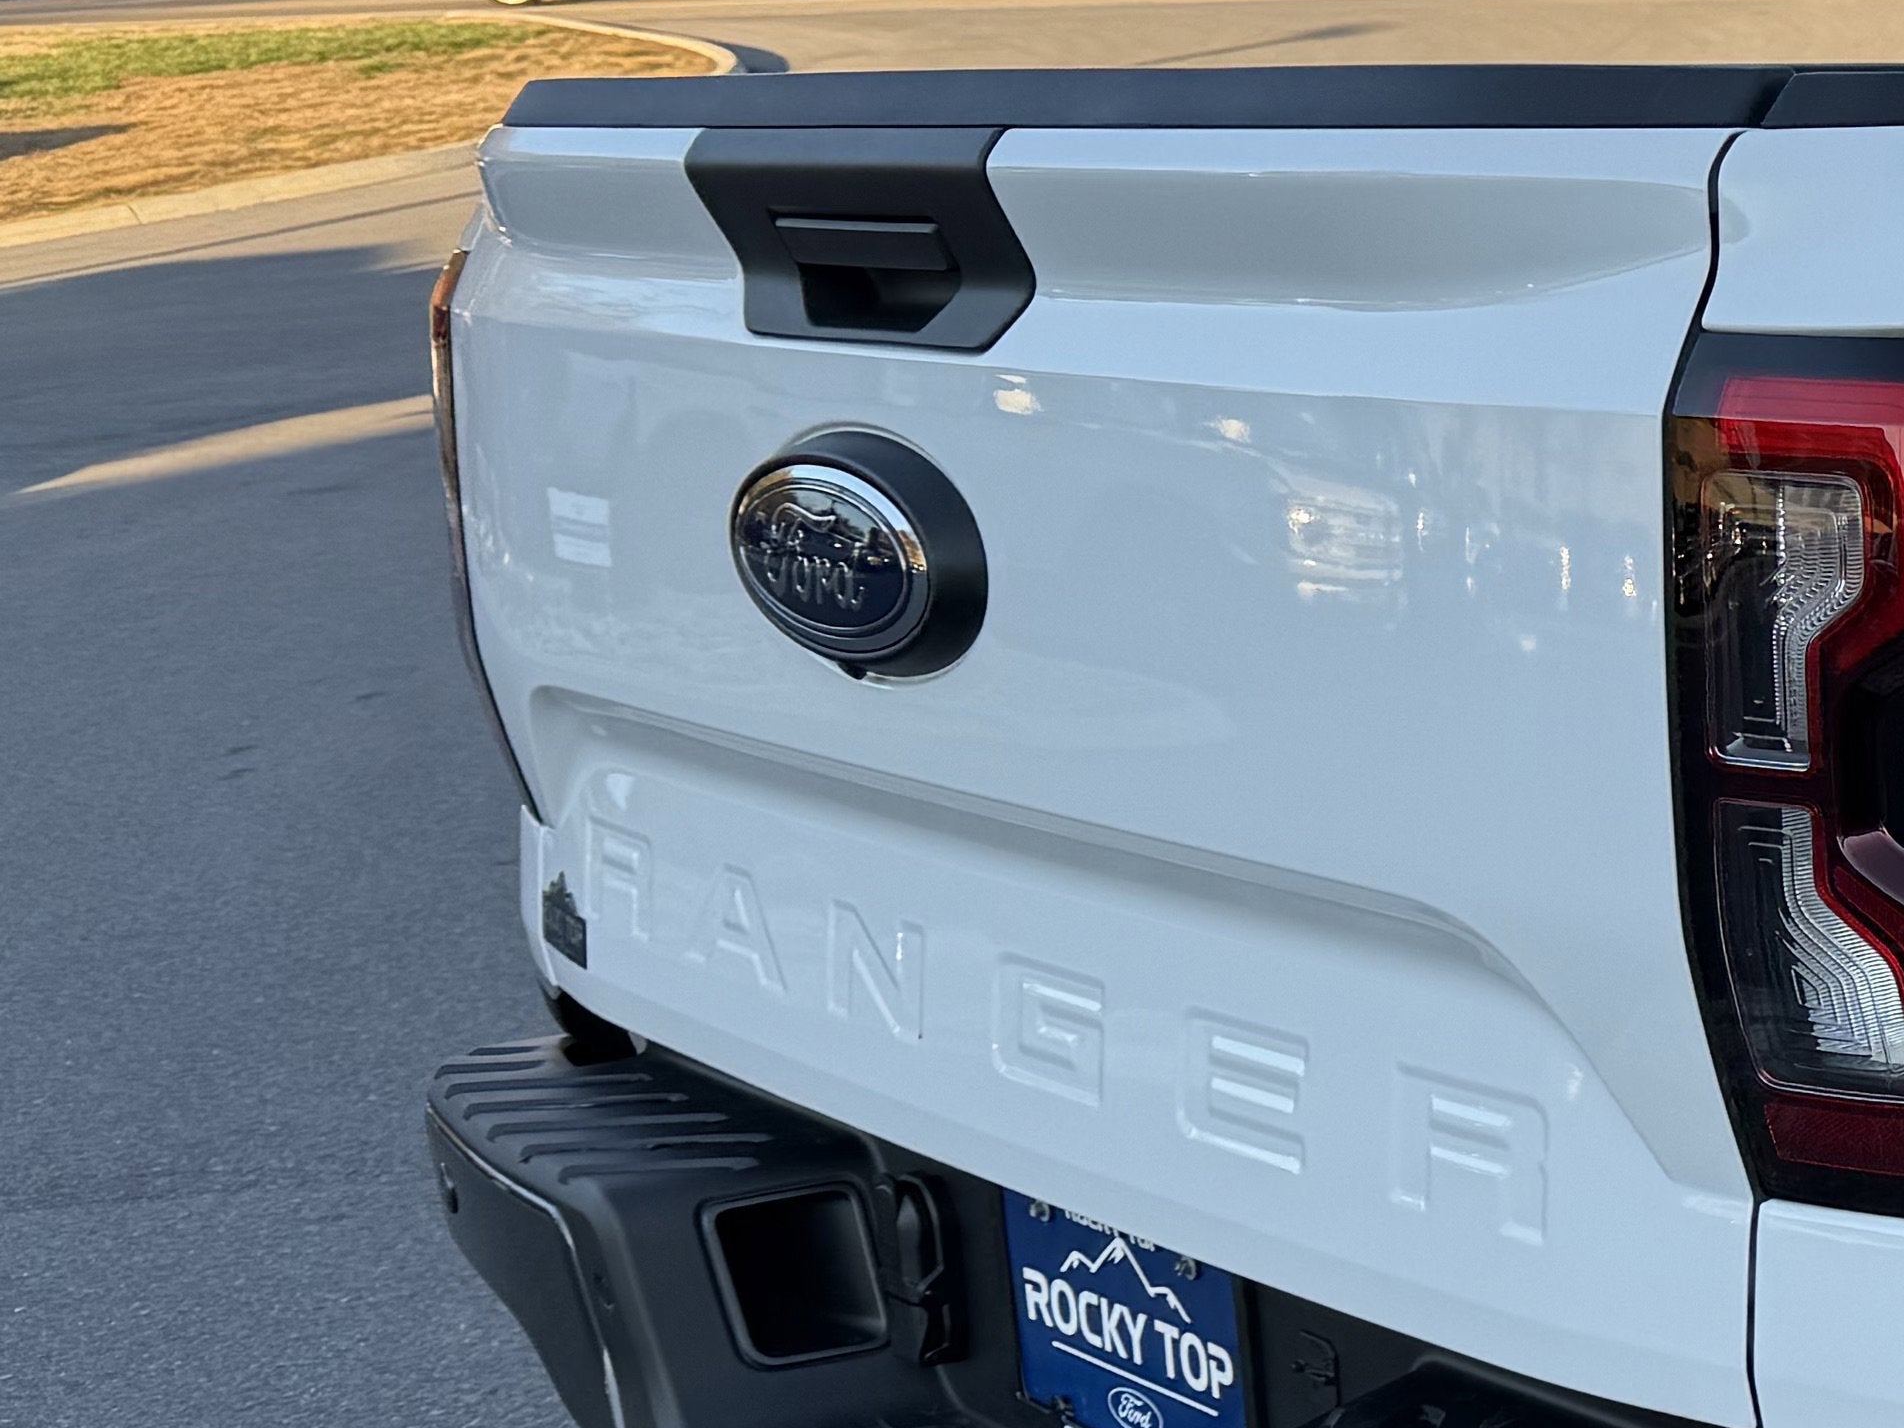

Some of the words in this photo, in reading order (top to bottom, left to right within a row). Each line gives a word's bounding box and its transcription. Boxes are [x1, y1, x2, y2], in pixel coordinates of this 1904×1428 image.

[585, 814, 1549, 1247] RANGER
[1022, 1267, 1148, 1366] ROCKY
[1154, 1318, 1235, 1400] TOP
